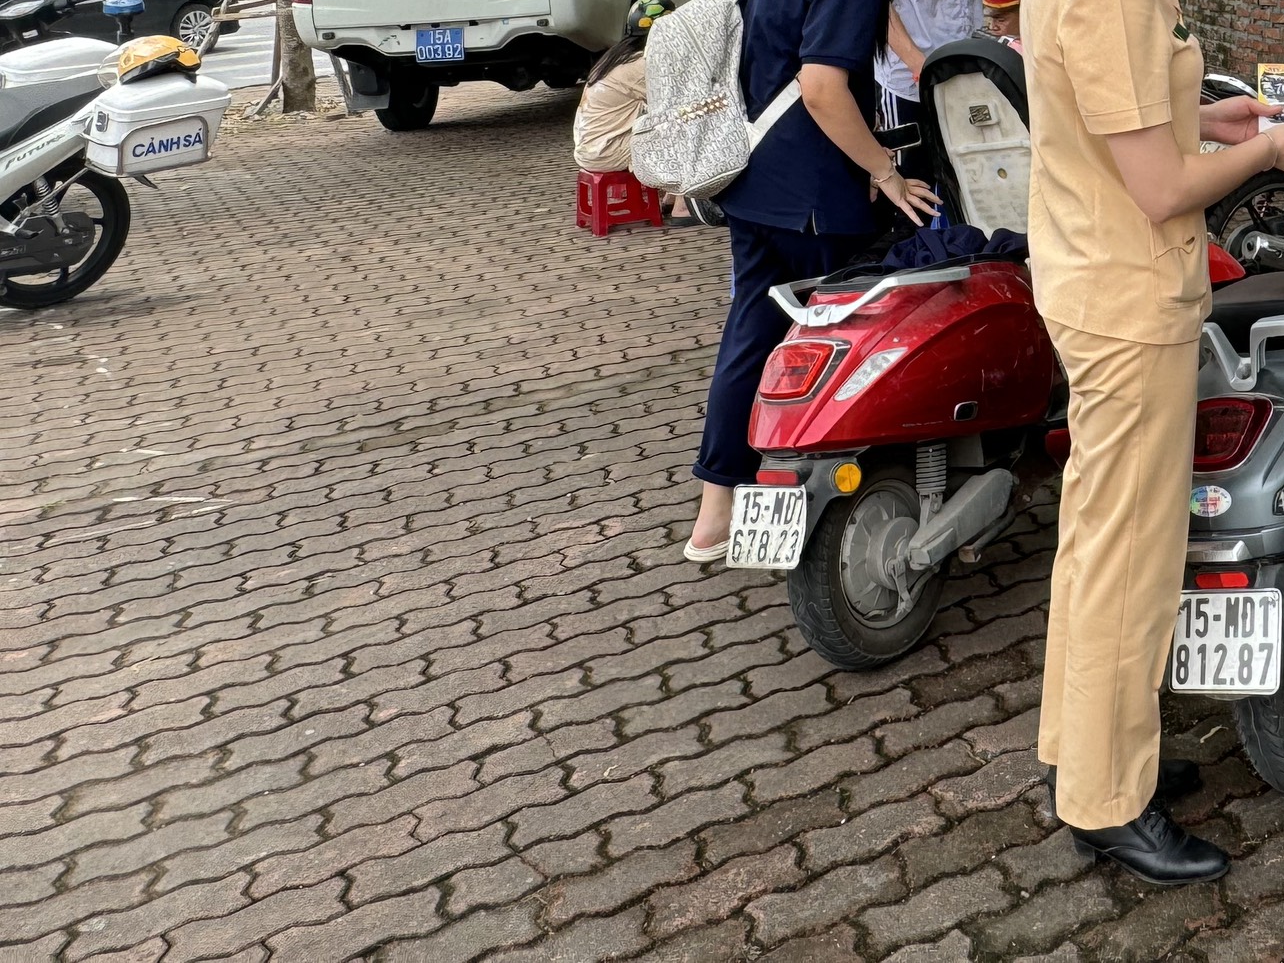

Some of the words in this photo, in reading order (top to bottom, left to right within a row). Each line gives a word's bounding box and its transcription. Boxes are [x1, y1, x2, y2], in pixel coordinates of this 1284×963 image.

[428, 29, 452, 45] 15A
[132, 136, 181, 158] CẢNH
[182, 127, 204, 149] SÁ
[731, 528, 800, 565] 678.23
[1175, 642, 1274, 686] 812.87
